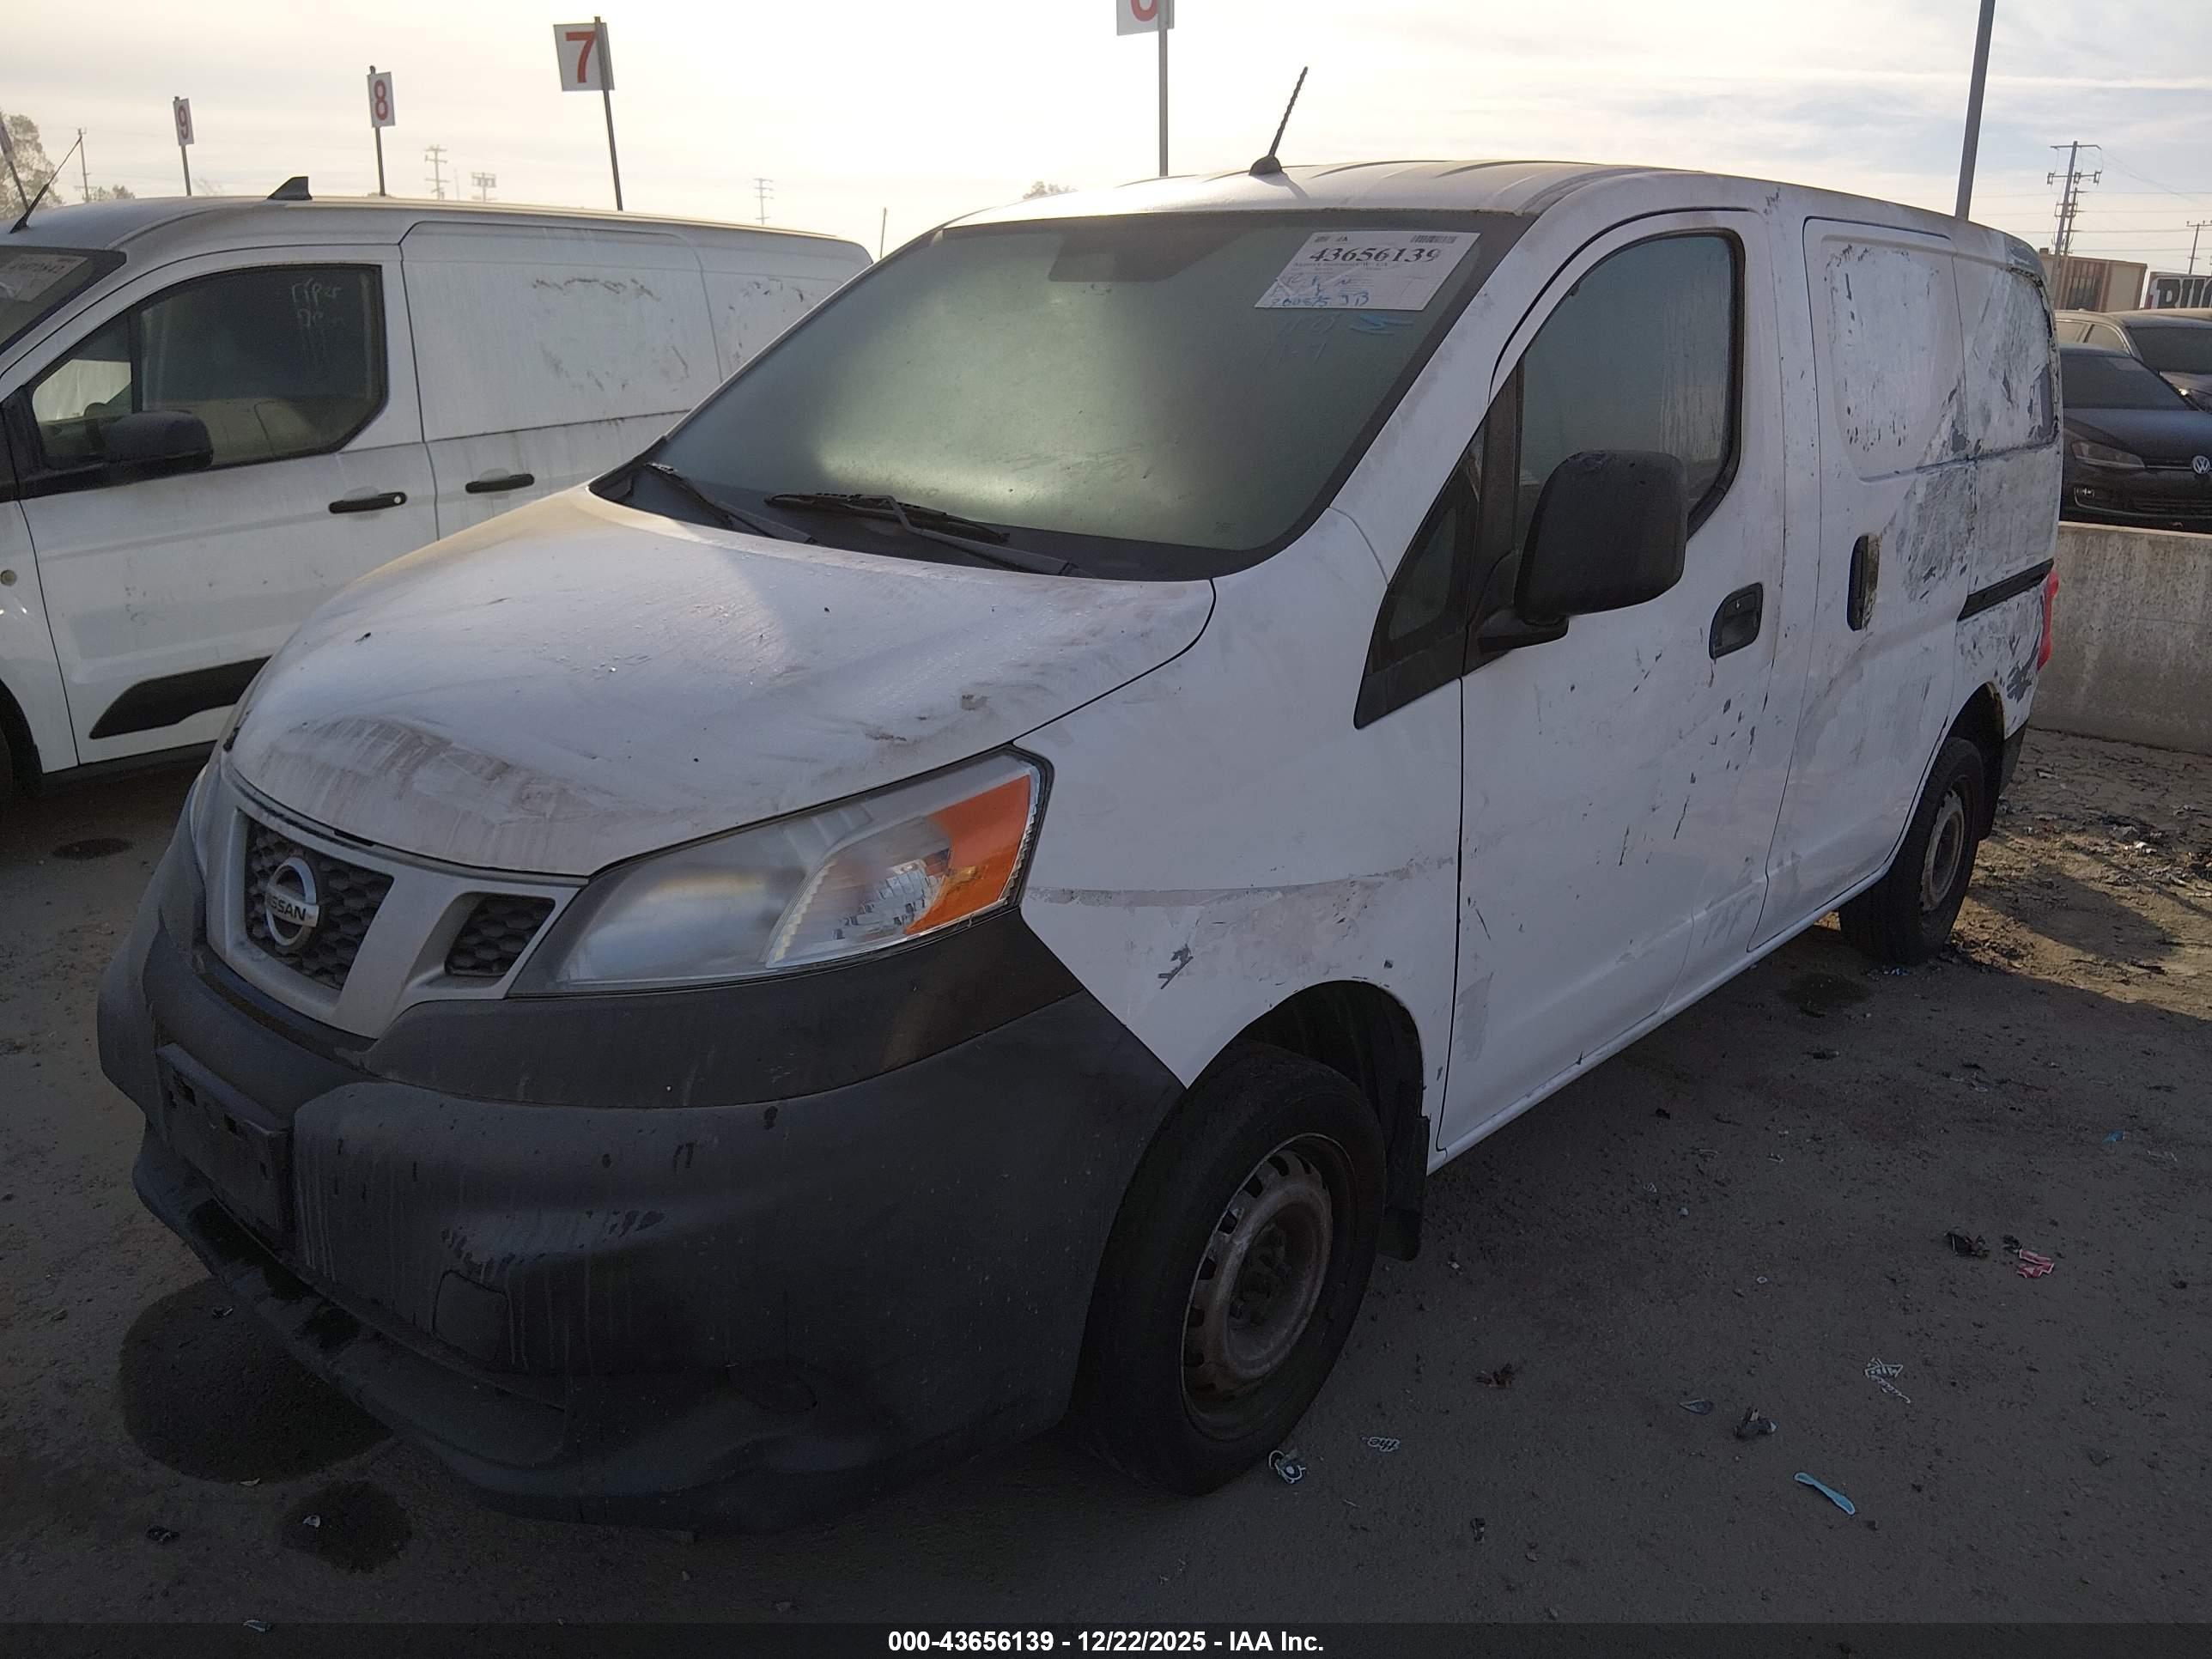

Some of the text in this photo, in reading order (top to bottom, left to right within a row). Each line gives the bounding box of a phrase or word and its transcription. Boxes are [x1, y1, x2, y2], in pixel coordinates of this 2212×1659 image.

[565, 31, 597, 83] 7
[374, 79, 389, 121] 8
[178, 105, 190, 140] 9
[1310, 247, 1442, 263] 43656139
